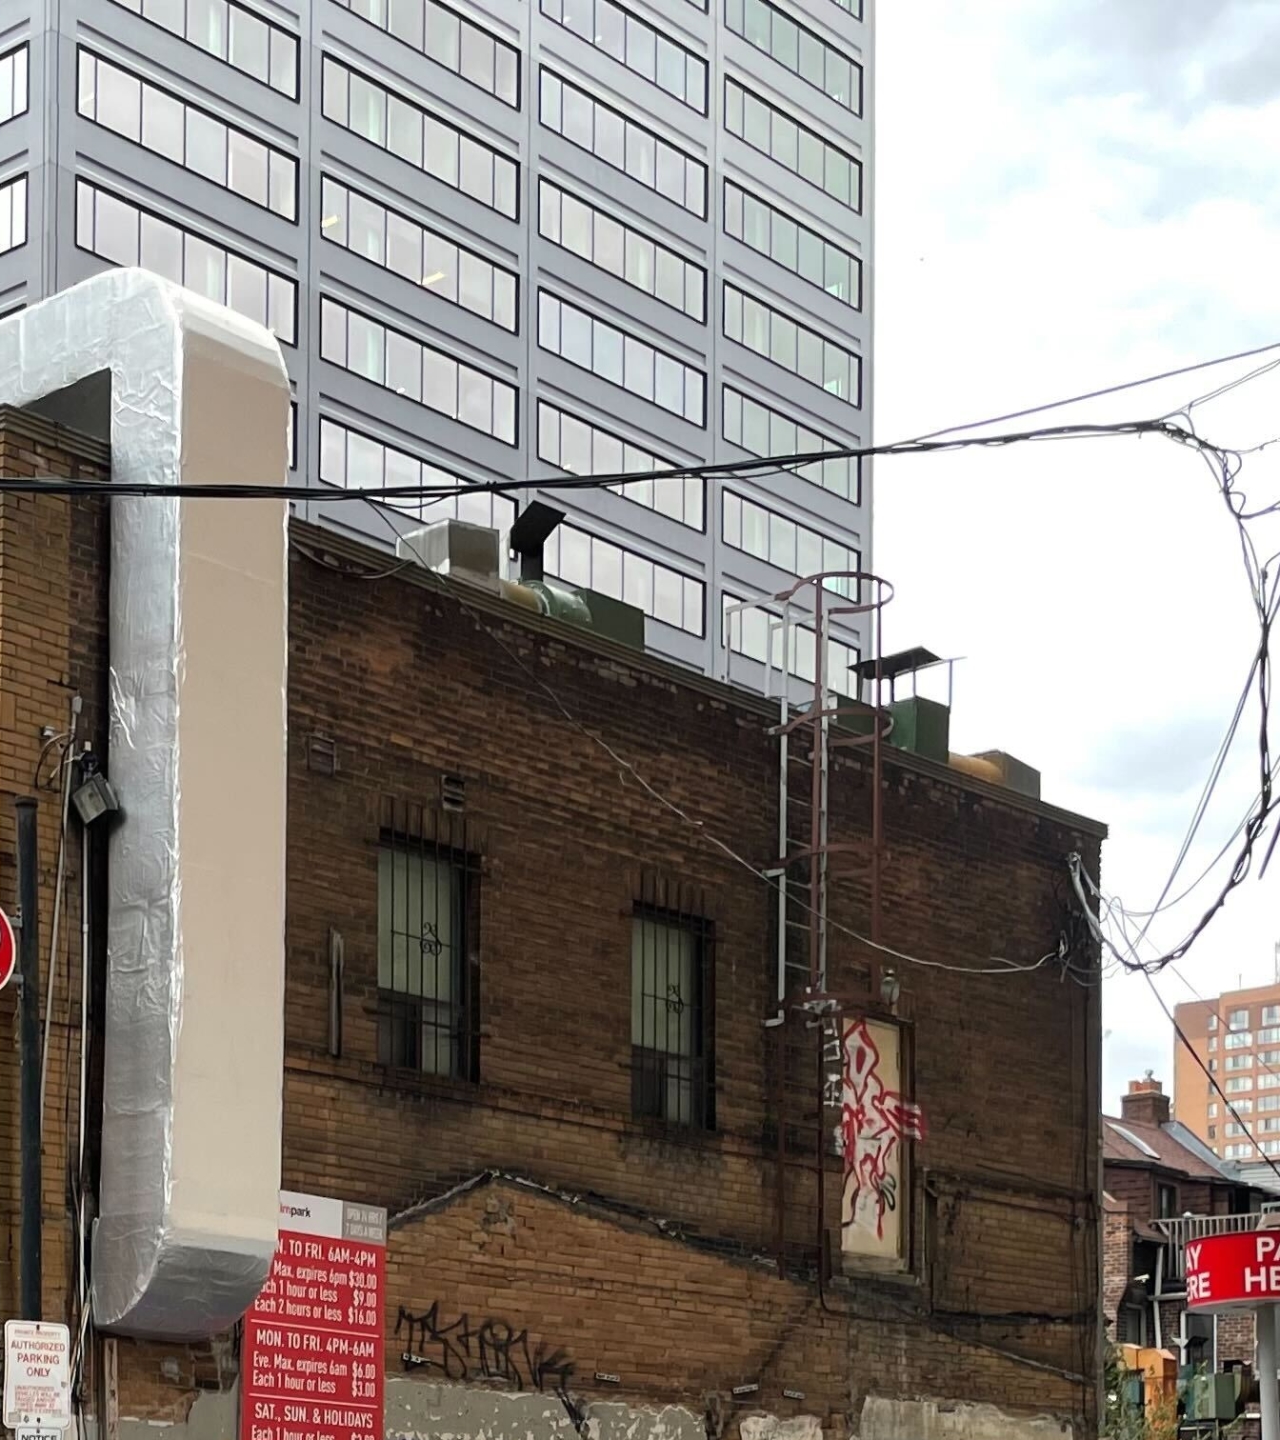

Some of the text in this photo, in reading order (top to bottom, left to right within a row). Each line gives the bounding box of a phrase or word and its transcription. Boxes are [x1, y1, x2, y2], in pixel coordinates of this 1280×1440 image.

[289, 1240, 301, 1256] TO
[305, 1242, 324, 1259] FRI.
[328, 1246, 376, 1267] 6AM-4PM
[1186, 1243, 1202, 1271] AY
[274, 1260, 377, 1290] Max. expires 6pm $30.00
[279, 1280, 284, 1295] 1
[287, 1282, 307, 1297] hour
[308, 1287, 317, 1299] or
[320, 1286, 337, 1302] less
[353, 1289, 377, 1308] $9.00
[255, 1295, 377, 1326] Each 2 hours or less $16.00
[11, 1341, 65, 1352] AUTHORIZED
[256, 1329, 374, 1357] MON. TO FRI. 4PM-6AM
[17, 1353, 59, 1364] PARKING
[27, 1368, 51, 1377] ONLY
[253, 1351, 375, 1380] Eve. Max. expires 6am $6.00
[253, 1370, 375, 1398] Each 1 hour or less $3.00
[255, 1403, 373, 1429] SAT., SUN. & HOLIDAYS
